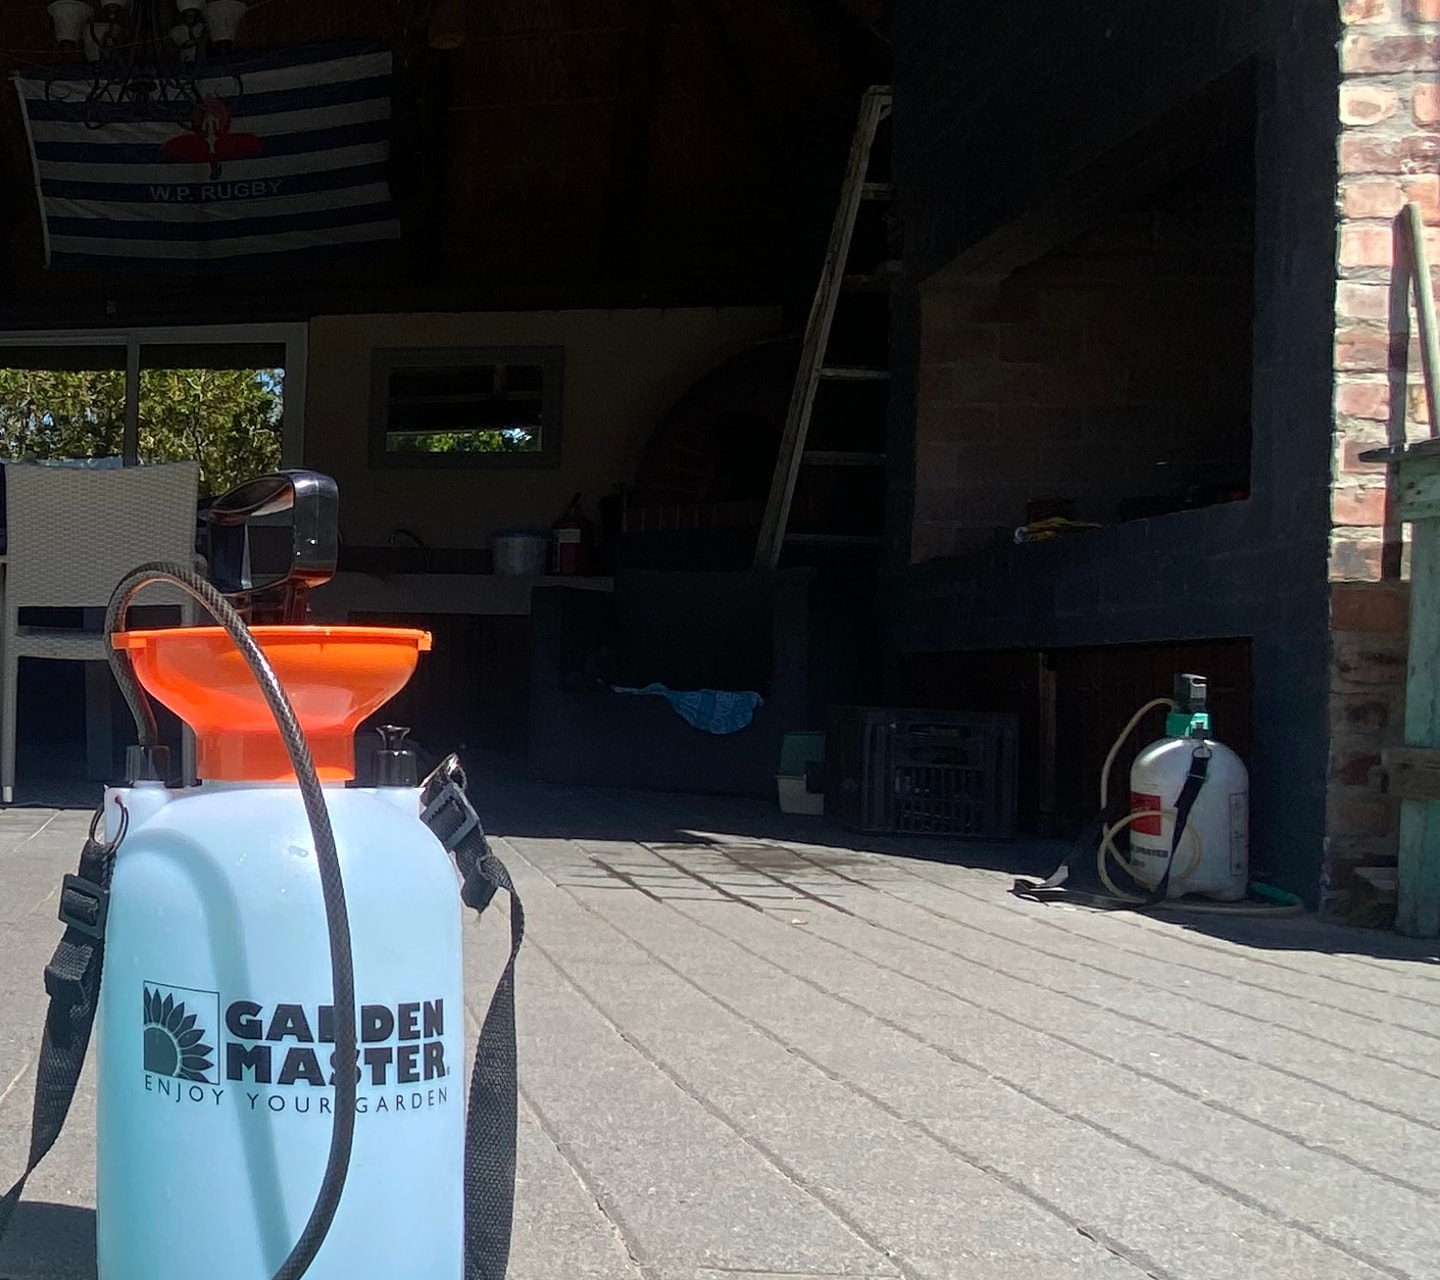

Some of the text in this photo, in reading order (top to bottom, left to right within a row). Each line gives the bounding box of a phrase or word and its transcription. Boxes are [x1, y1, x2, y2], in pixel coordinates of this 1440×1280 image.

[149, 179, 283, 202] W.P. RUGBY
[145, 1075, 448, 1114] ENJOY YOUR GARDEN
